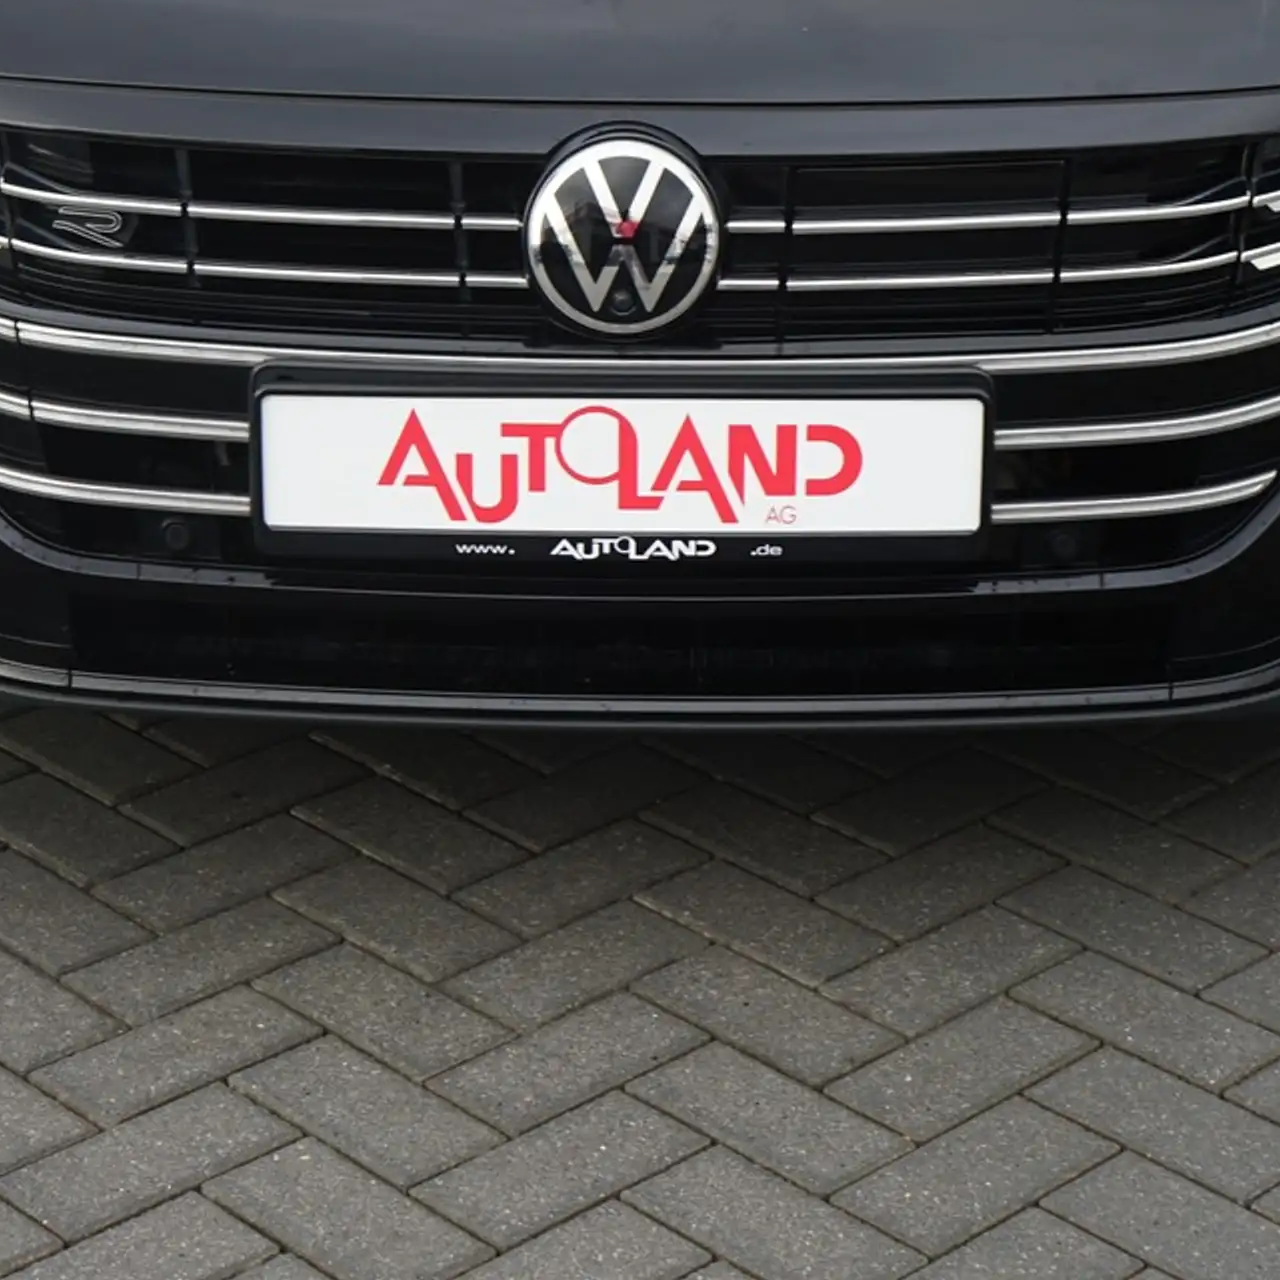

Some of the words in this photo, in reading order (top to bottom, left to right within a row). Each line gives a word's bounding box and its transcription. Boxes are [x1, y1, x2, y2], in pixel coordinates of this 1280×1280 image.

[376, 405, 863, 525] AUTOLAND
[765, 504, 797, 525] AG
[455, 542, 516, 555] www.
[550, 535, 717, 561] AUTOLAND
[749, 542, 783, 556] .de
